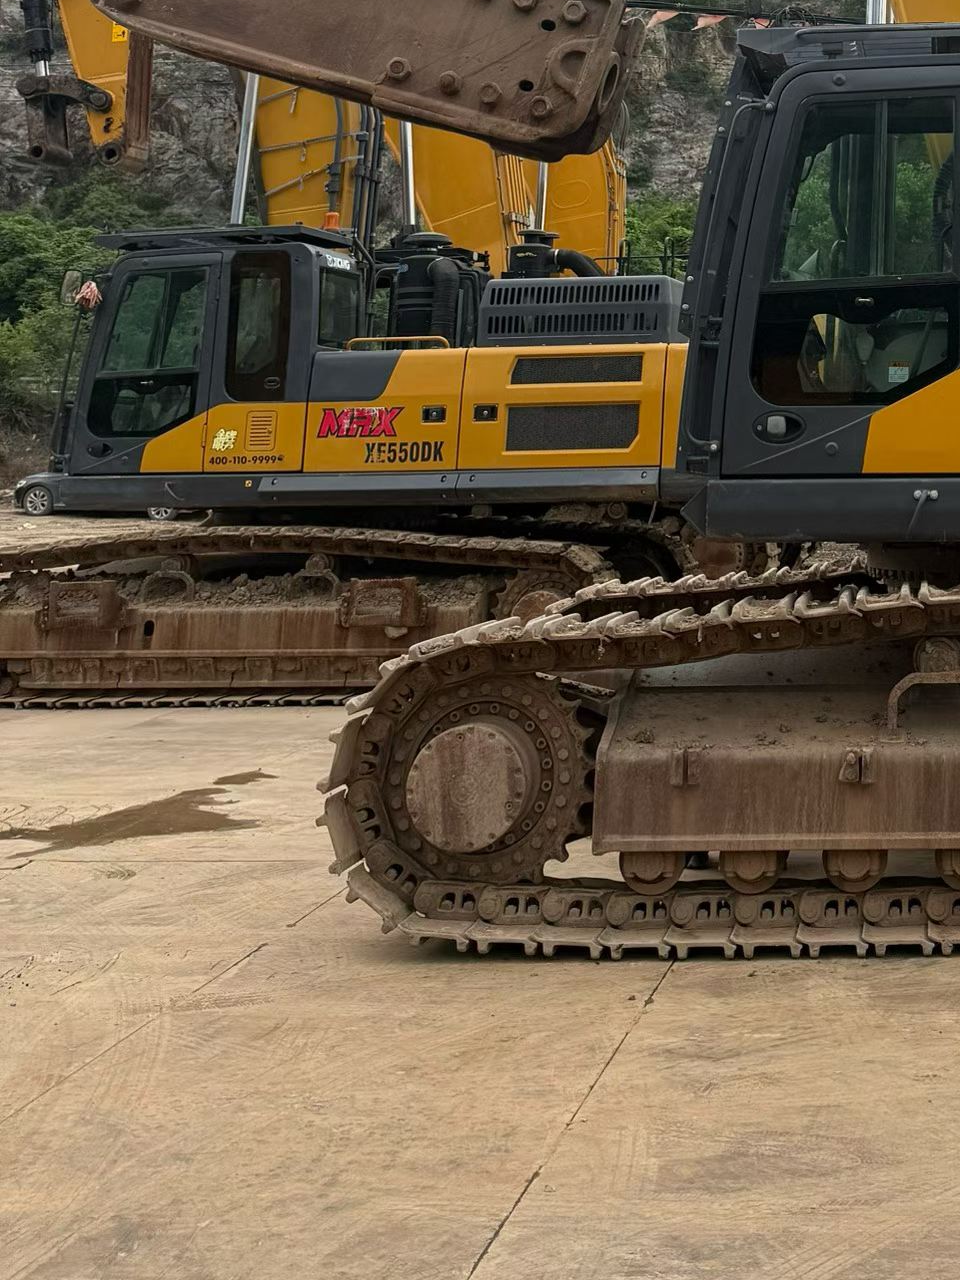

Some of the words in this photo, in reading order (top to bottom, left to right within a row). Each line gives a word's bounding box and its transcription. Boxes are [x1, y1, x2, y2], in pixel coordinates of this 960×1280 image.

[317, 406, 404, 438] MAX
[209, 455, 277, 465] 400-110-9999
[364, 441, 445, 463] XE550DK
